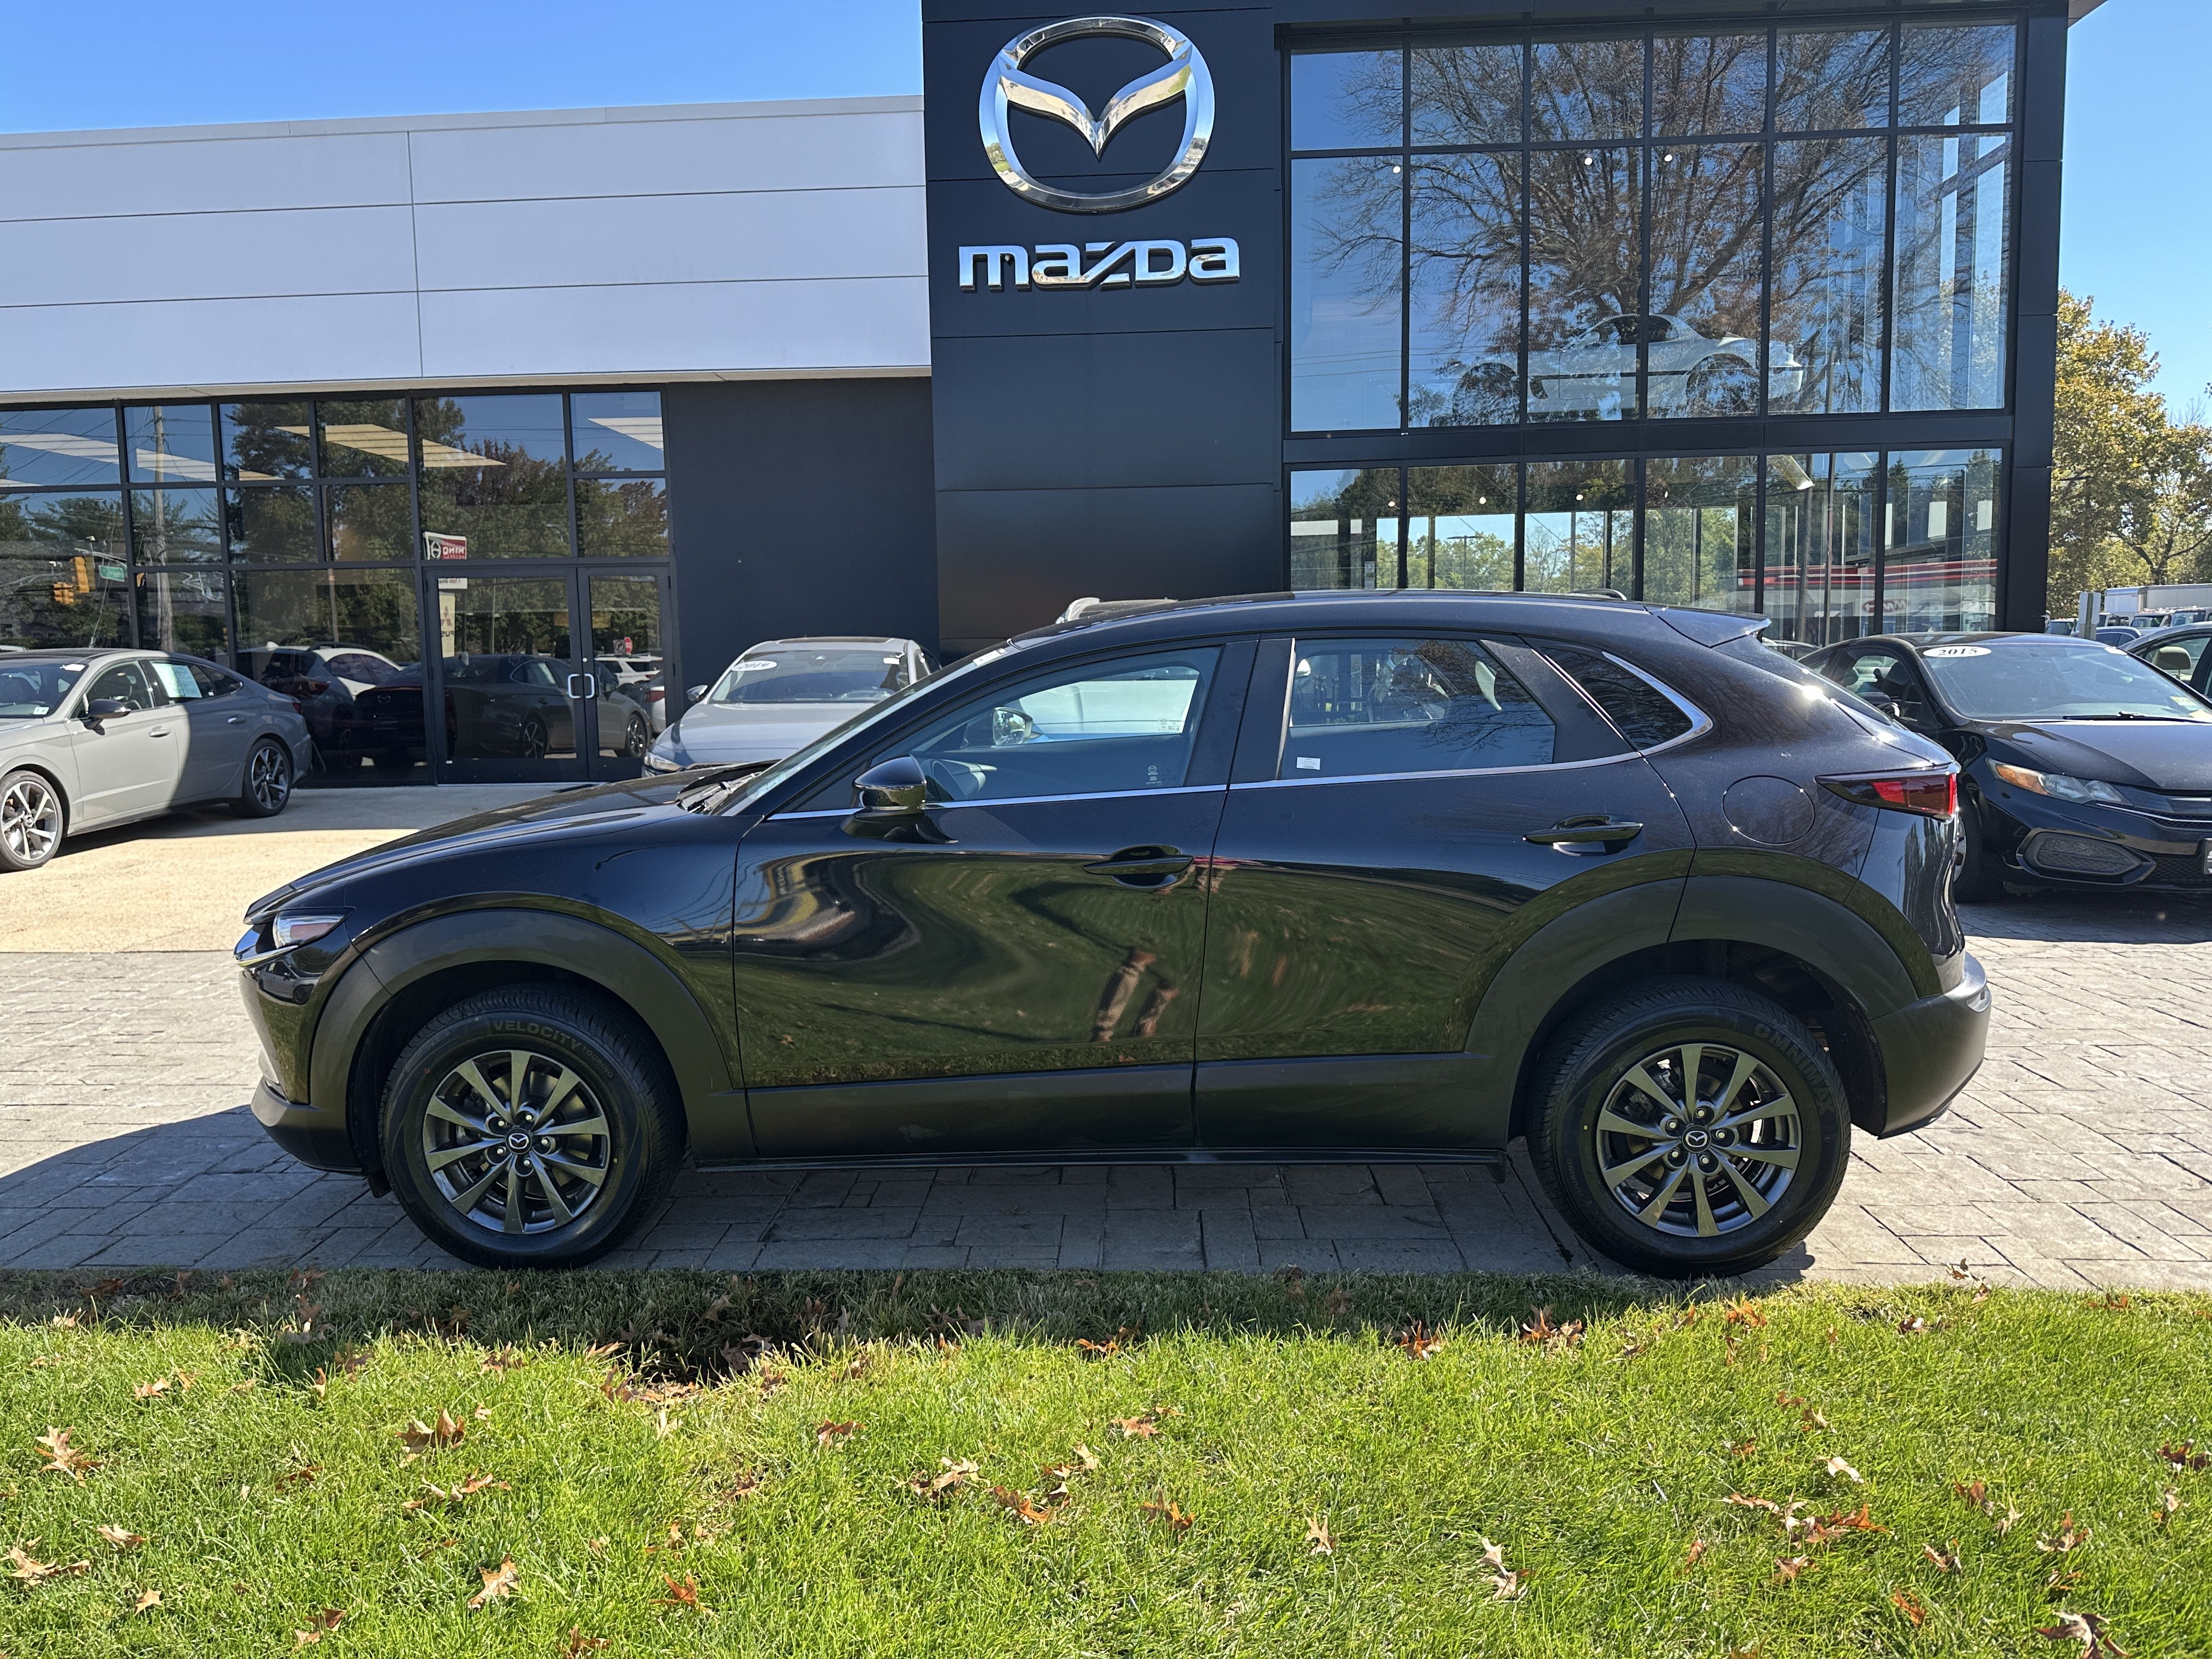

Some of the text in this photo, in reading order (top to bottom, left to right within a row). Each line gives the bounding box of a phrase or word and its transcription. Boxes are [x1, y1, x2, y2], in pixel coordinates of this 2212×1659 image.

[492, 1020, 614, 1078] VELOCITY TOURING
[1754, 1023, 1835, 1114] OMNIMAX
